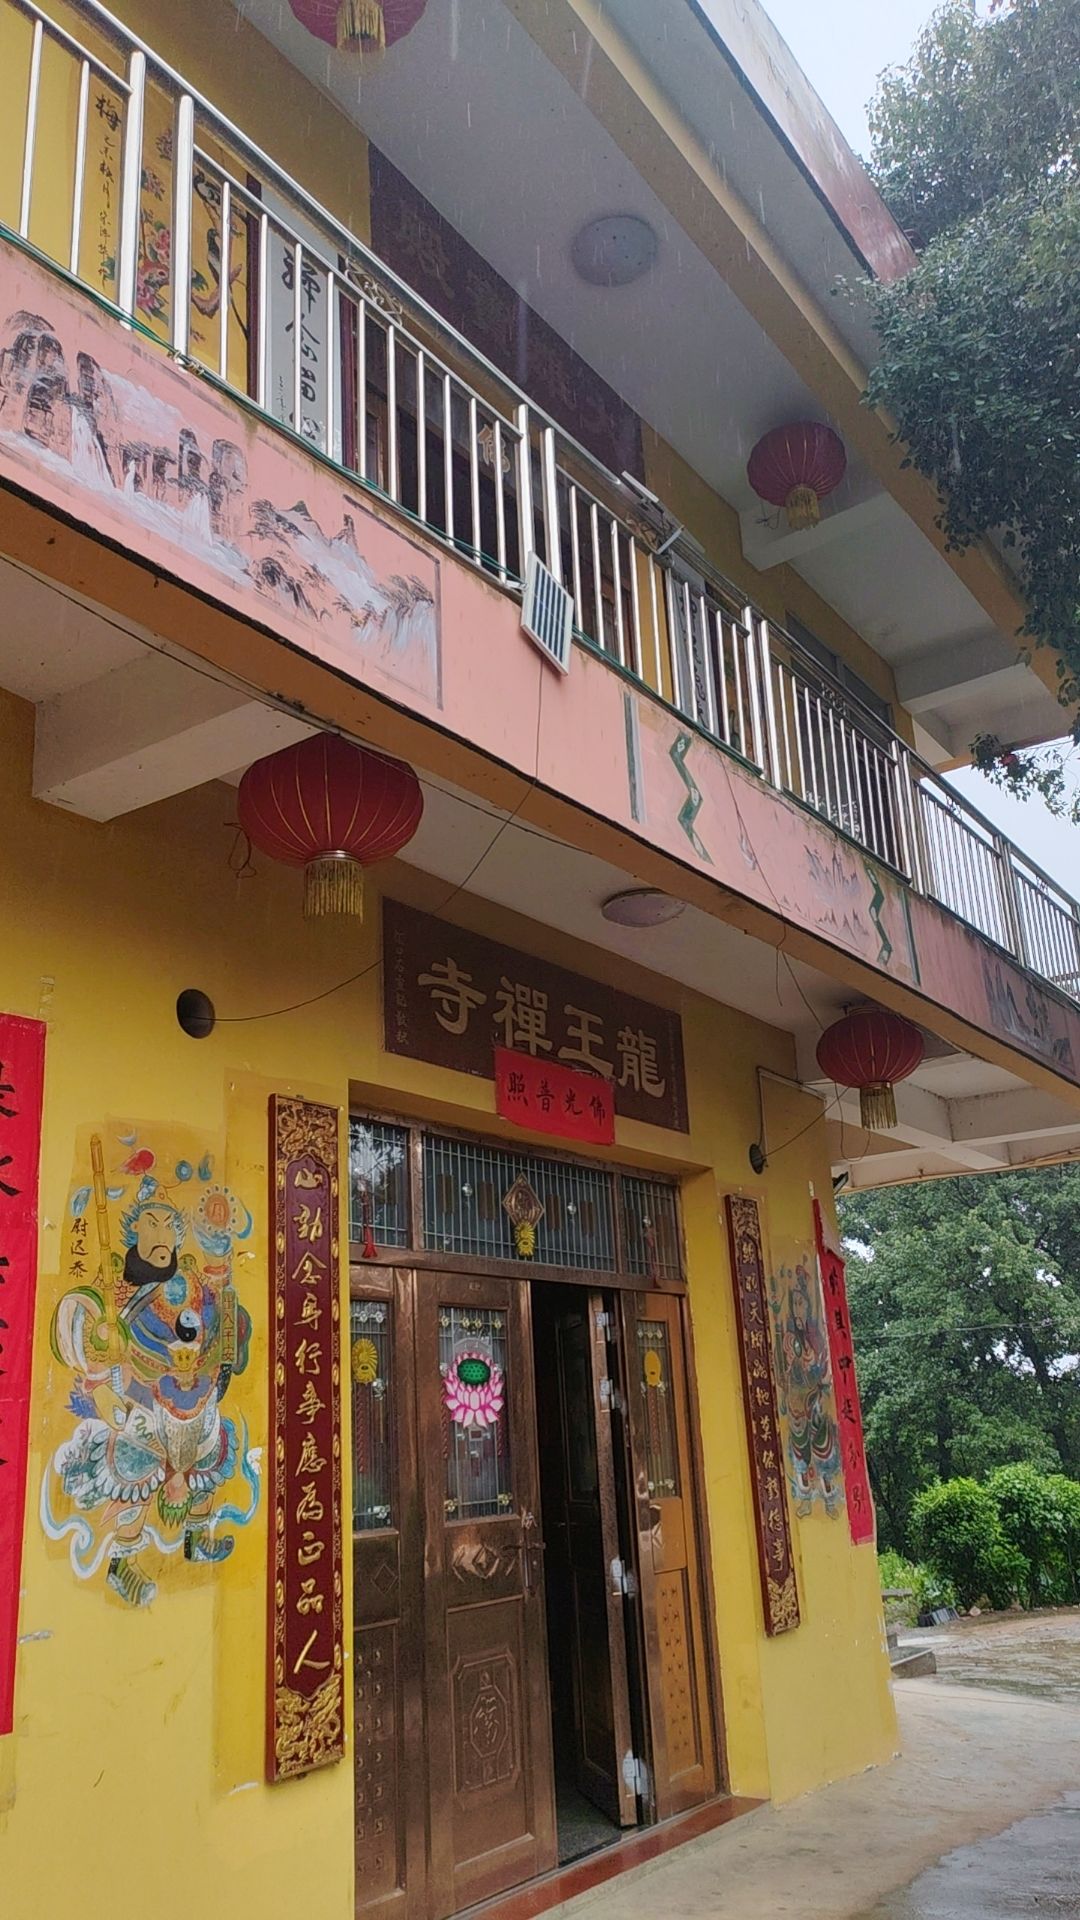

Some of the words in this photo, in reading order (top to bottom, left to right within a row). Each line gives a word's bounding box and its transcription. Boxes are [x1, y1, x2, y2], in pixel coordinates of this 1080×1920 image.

[417, 957, 666, 1098] 龍王禪寺
[507, 1071, 606, 1126] 佛光普照
